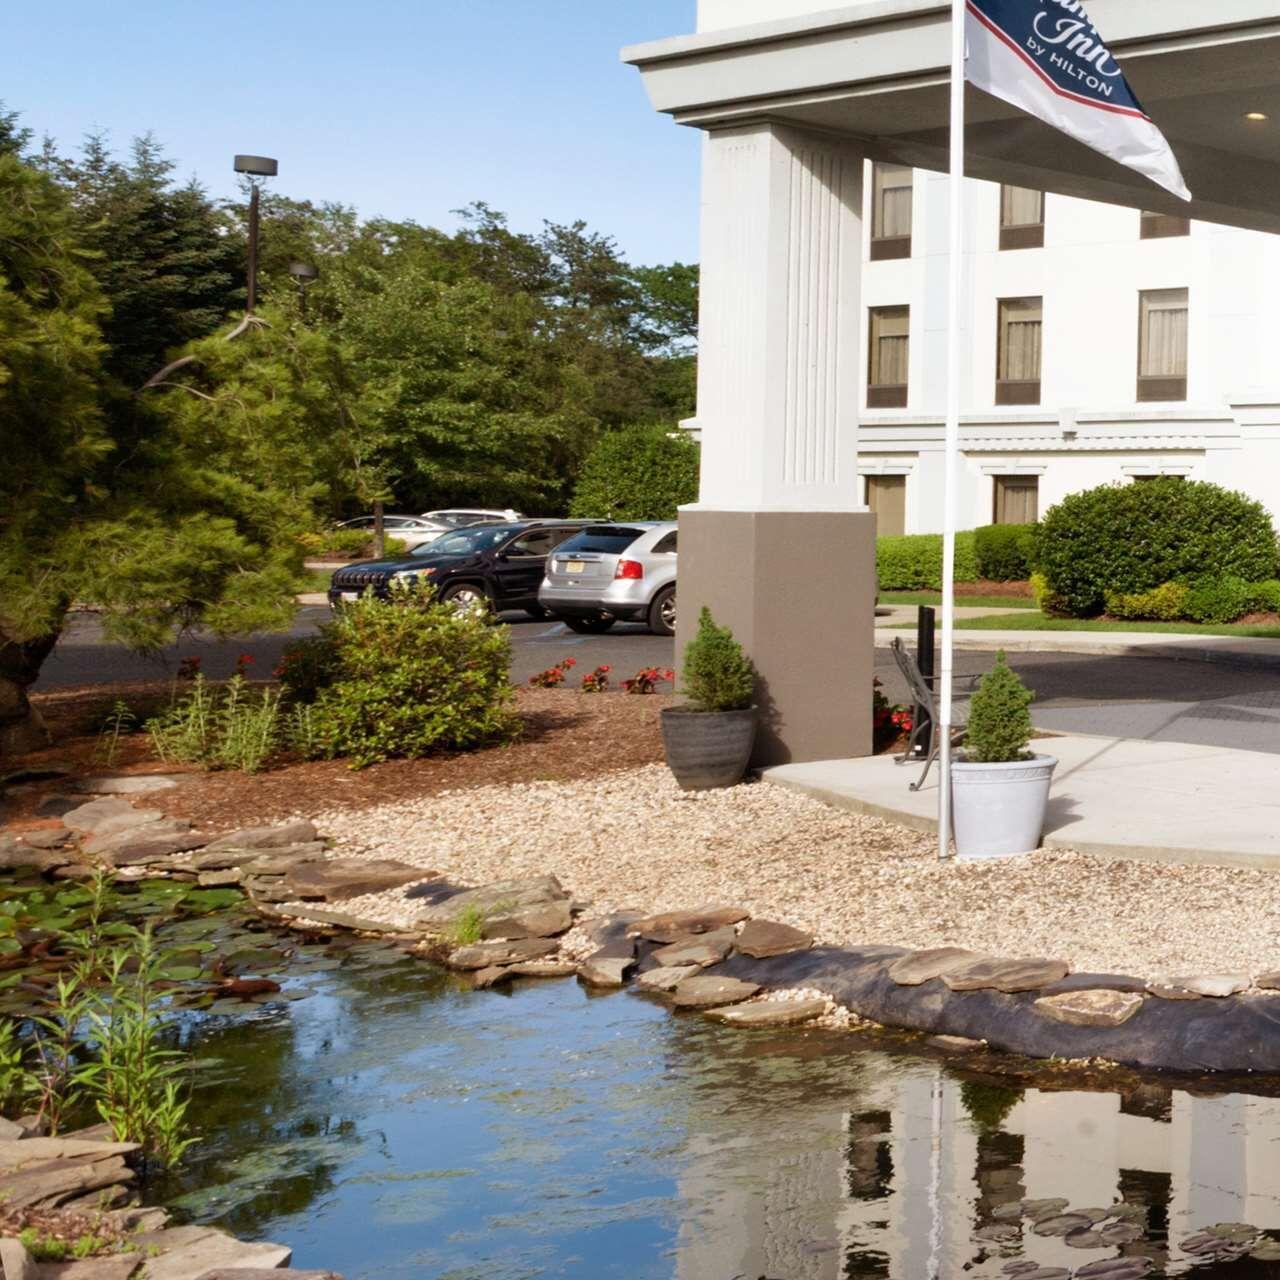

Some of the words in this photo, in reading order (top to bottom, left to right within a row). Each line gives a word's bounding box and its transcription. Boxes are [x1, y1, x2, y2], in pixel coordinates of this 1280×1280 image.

[1026, 36, 1046, 56] by
[1049, 52, 1113, 96] HILTON
[1033, 11, 1122, 76] Inn
